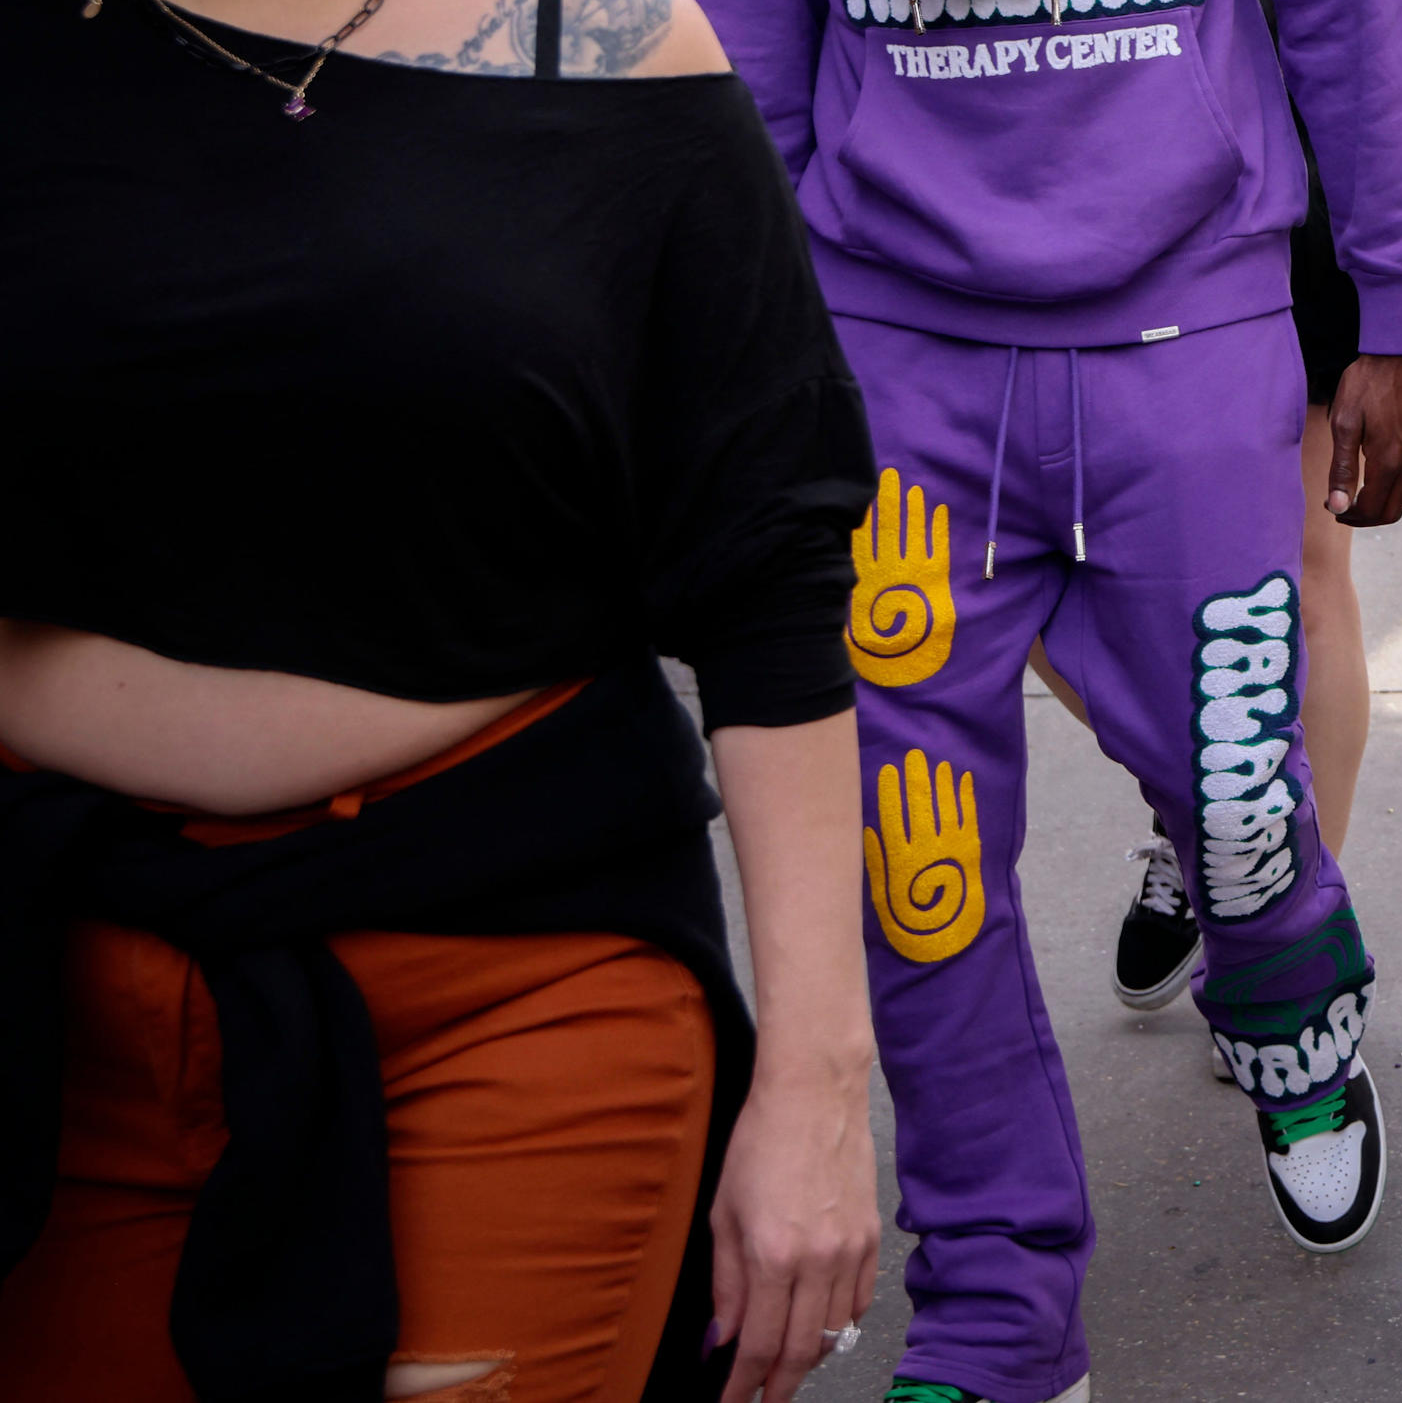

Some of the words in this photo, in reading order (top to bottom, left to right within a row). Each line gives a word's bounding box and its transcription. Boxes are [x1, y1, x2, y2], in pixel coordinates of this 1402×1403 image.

[886, 36, 1042, 80] THERAPY
[1046, 23, 1183, 71] CENTER
[1214, 981, 1377, 1098] VALA
